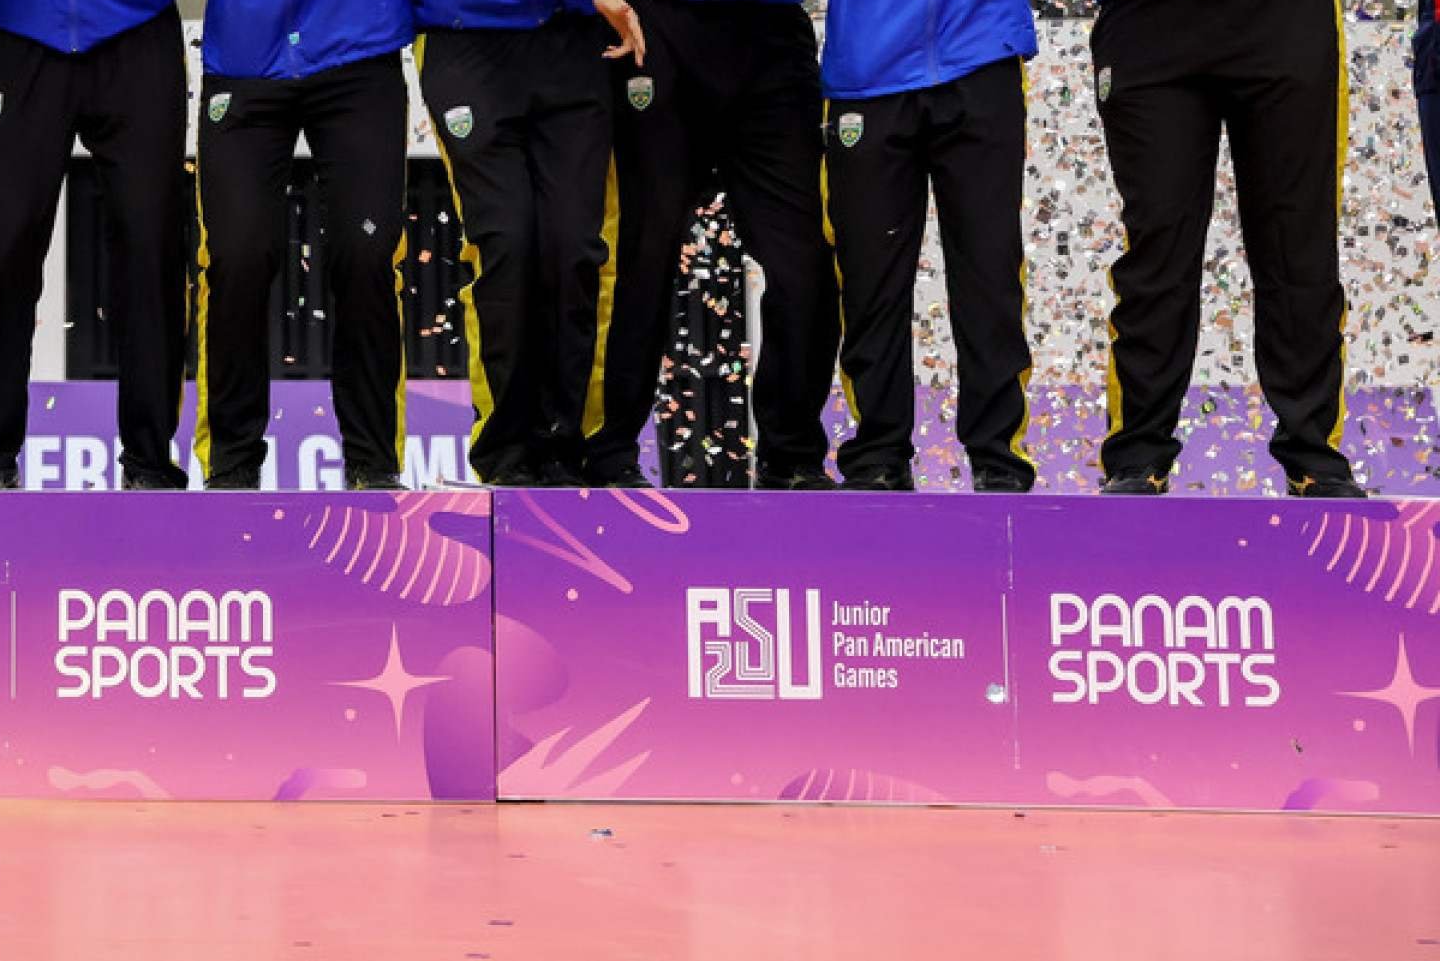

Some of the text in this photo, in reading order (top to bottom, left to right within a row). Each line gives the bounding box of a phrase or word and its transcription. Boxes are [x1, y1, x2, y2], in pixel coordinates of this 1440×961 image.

[57, 589, 274, 643] PANAM
[831, 600, 892, 627] Junior
[1049, 592, 1274, 651] PANAM
[832, 630, 965, 658] Pan American
[54, 645, 277, 699] SPORTS
[832, 661, 899, 689] Games
[1048, 649, 1281, 707] SPORTS
